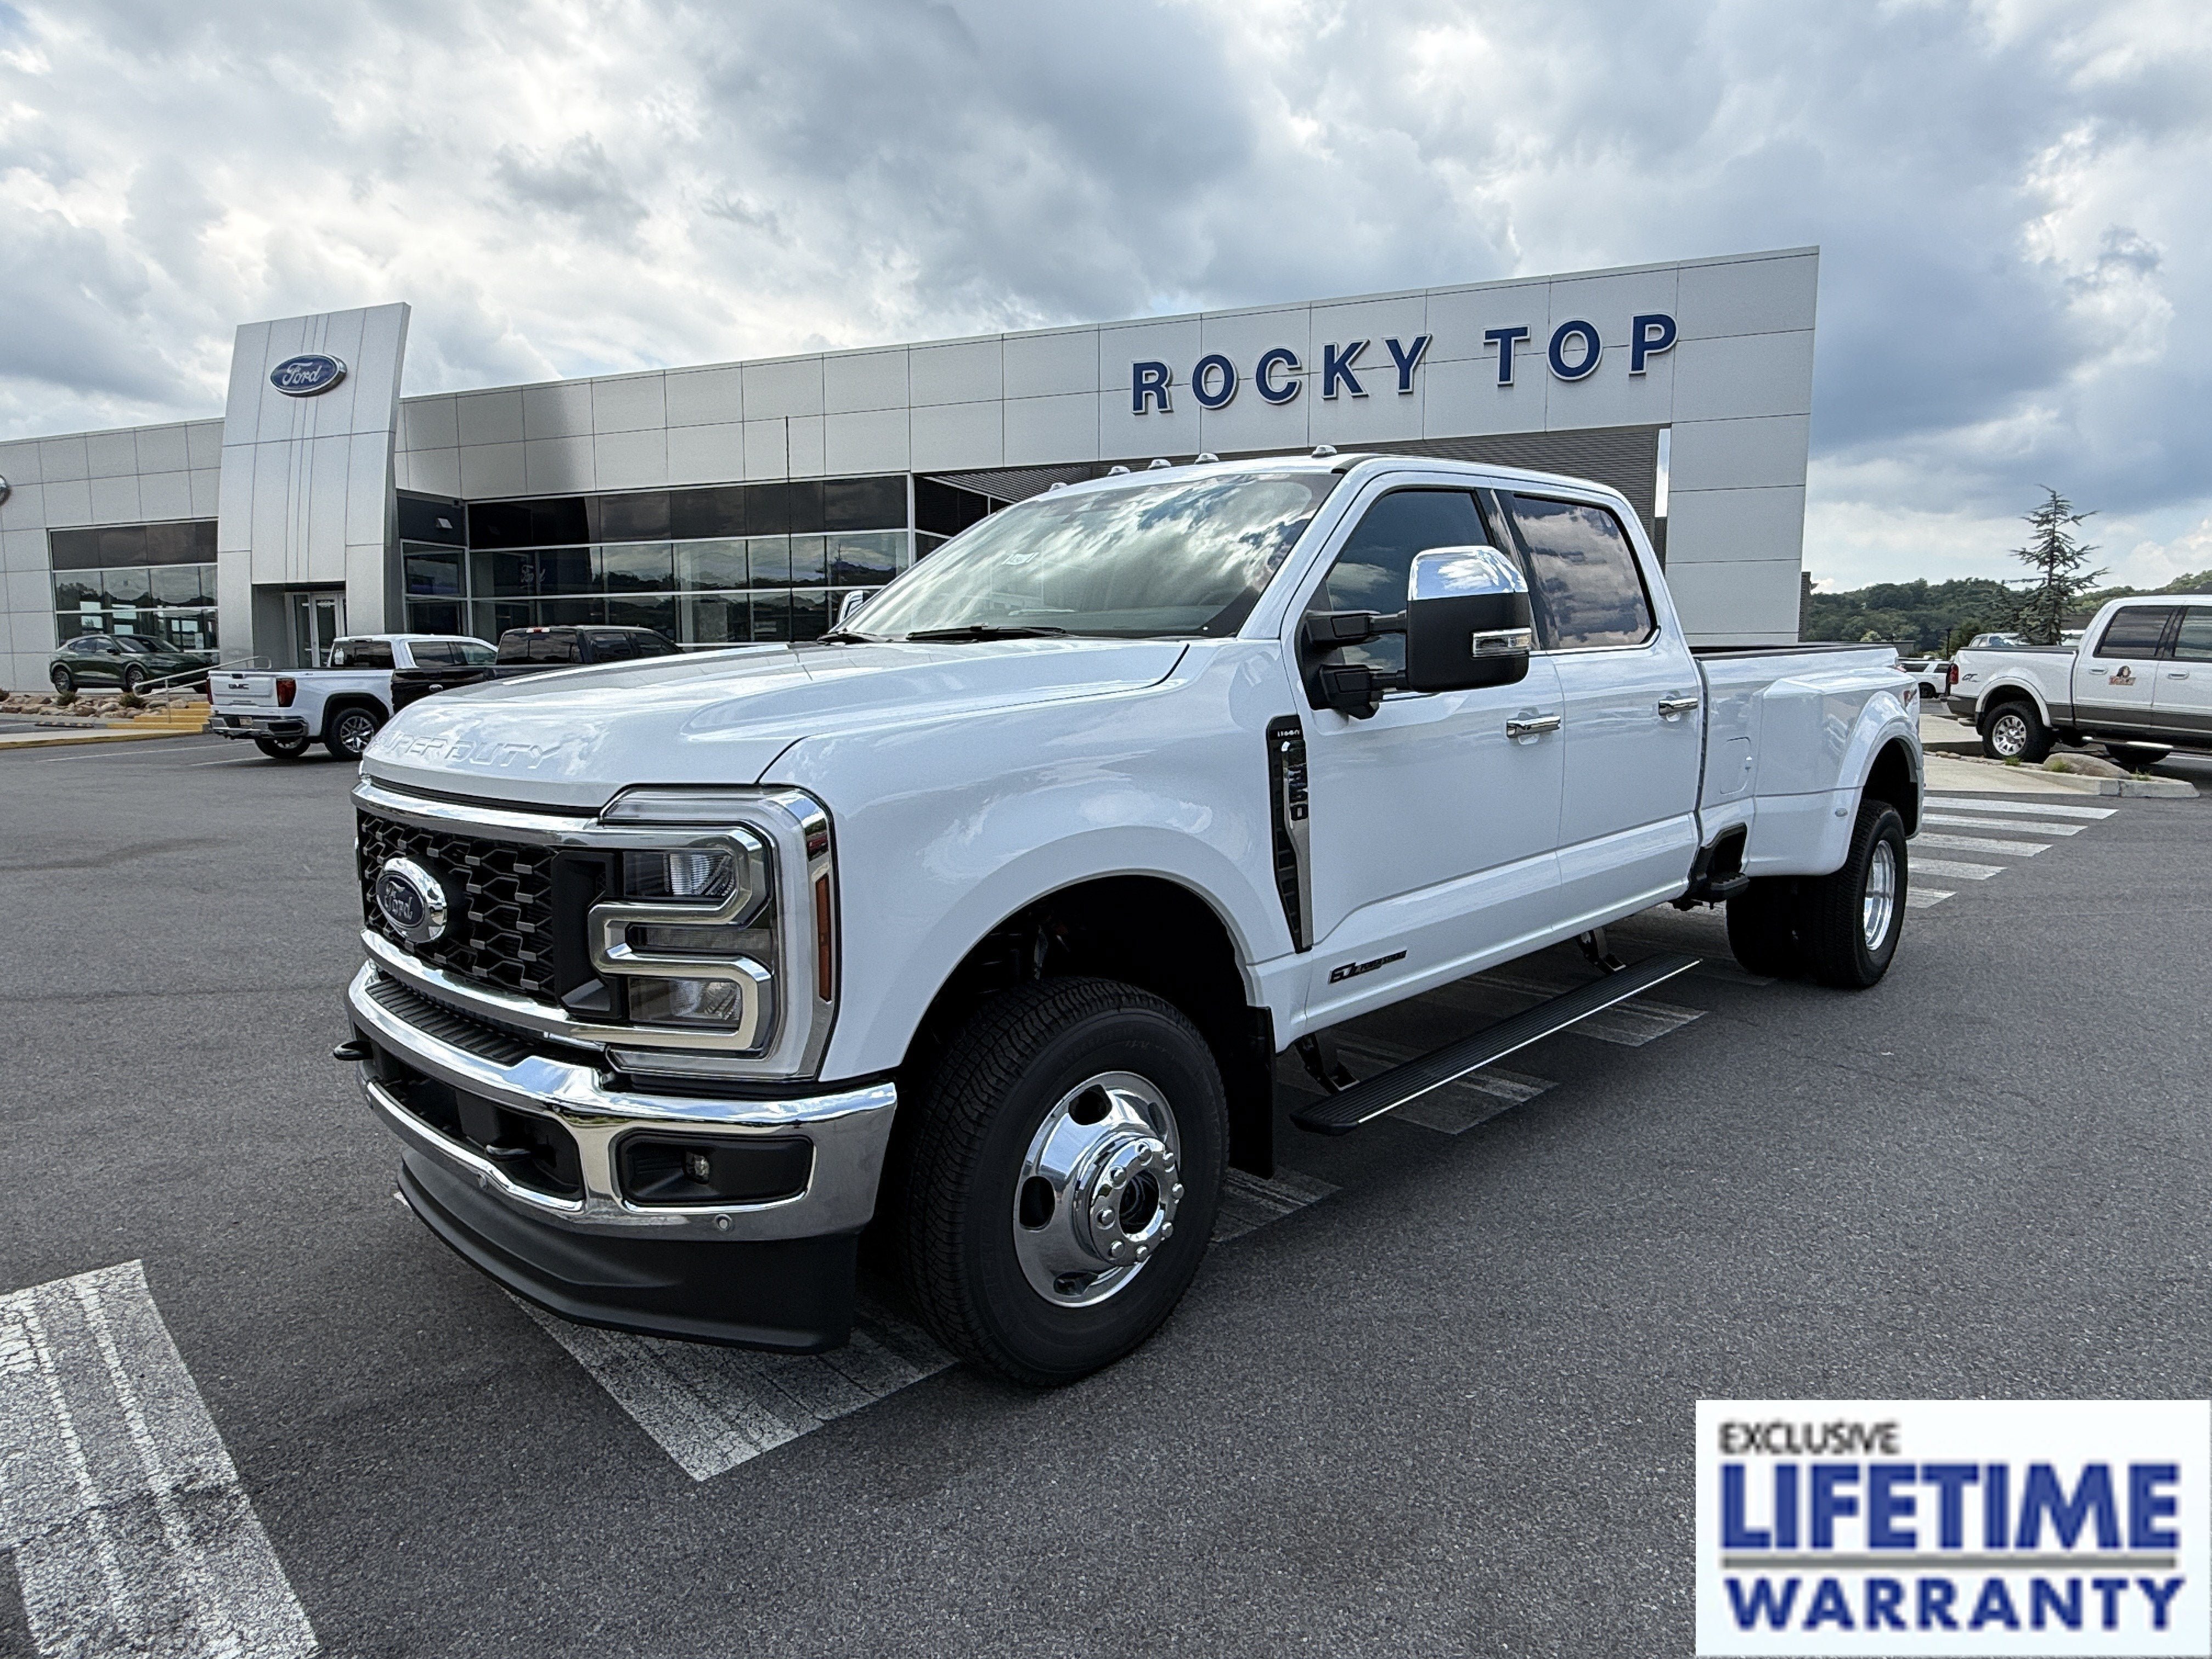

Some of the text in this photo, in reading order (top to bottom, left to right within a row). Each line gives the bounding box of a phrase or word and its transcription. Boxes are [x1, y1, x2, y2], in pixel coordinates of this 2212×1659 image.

[282, 362, 323, 385] Ford
[1131, 312, 1679, 414] ROCKY TOP
[445, 741, 562, 769] DUTY
[384, 881, 413, 920] Ford
